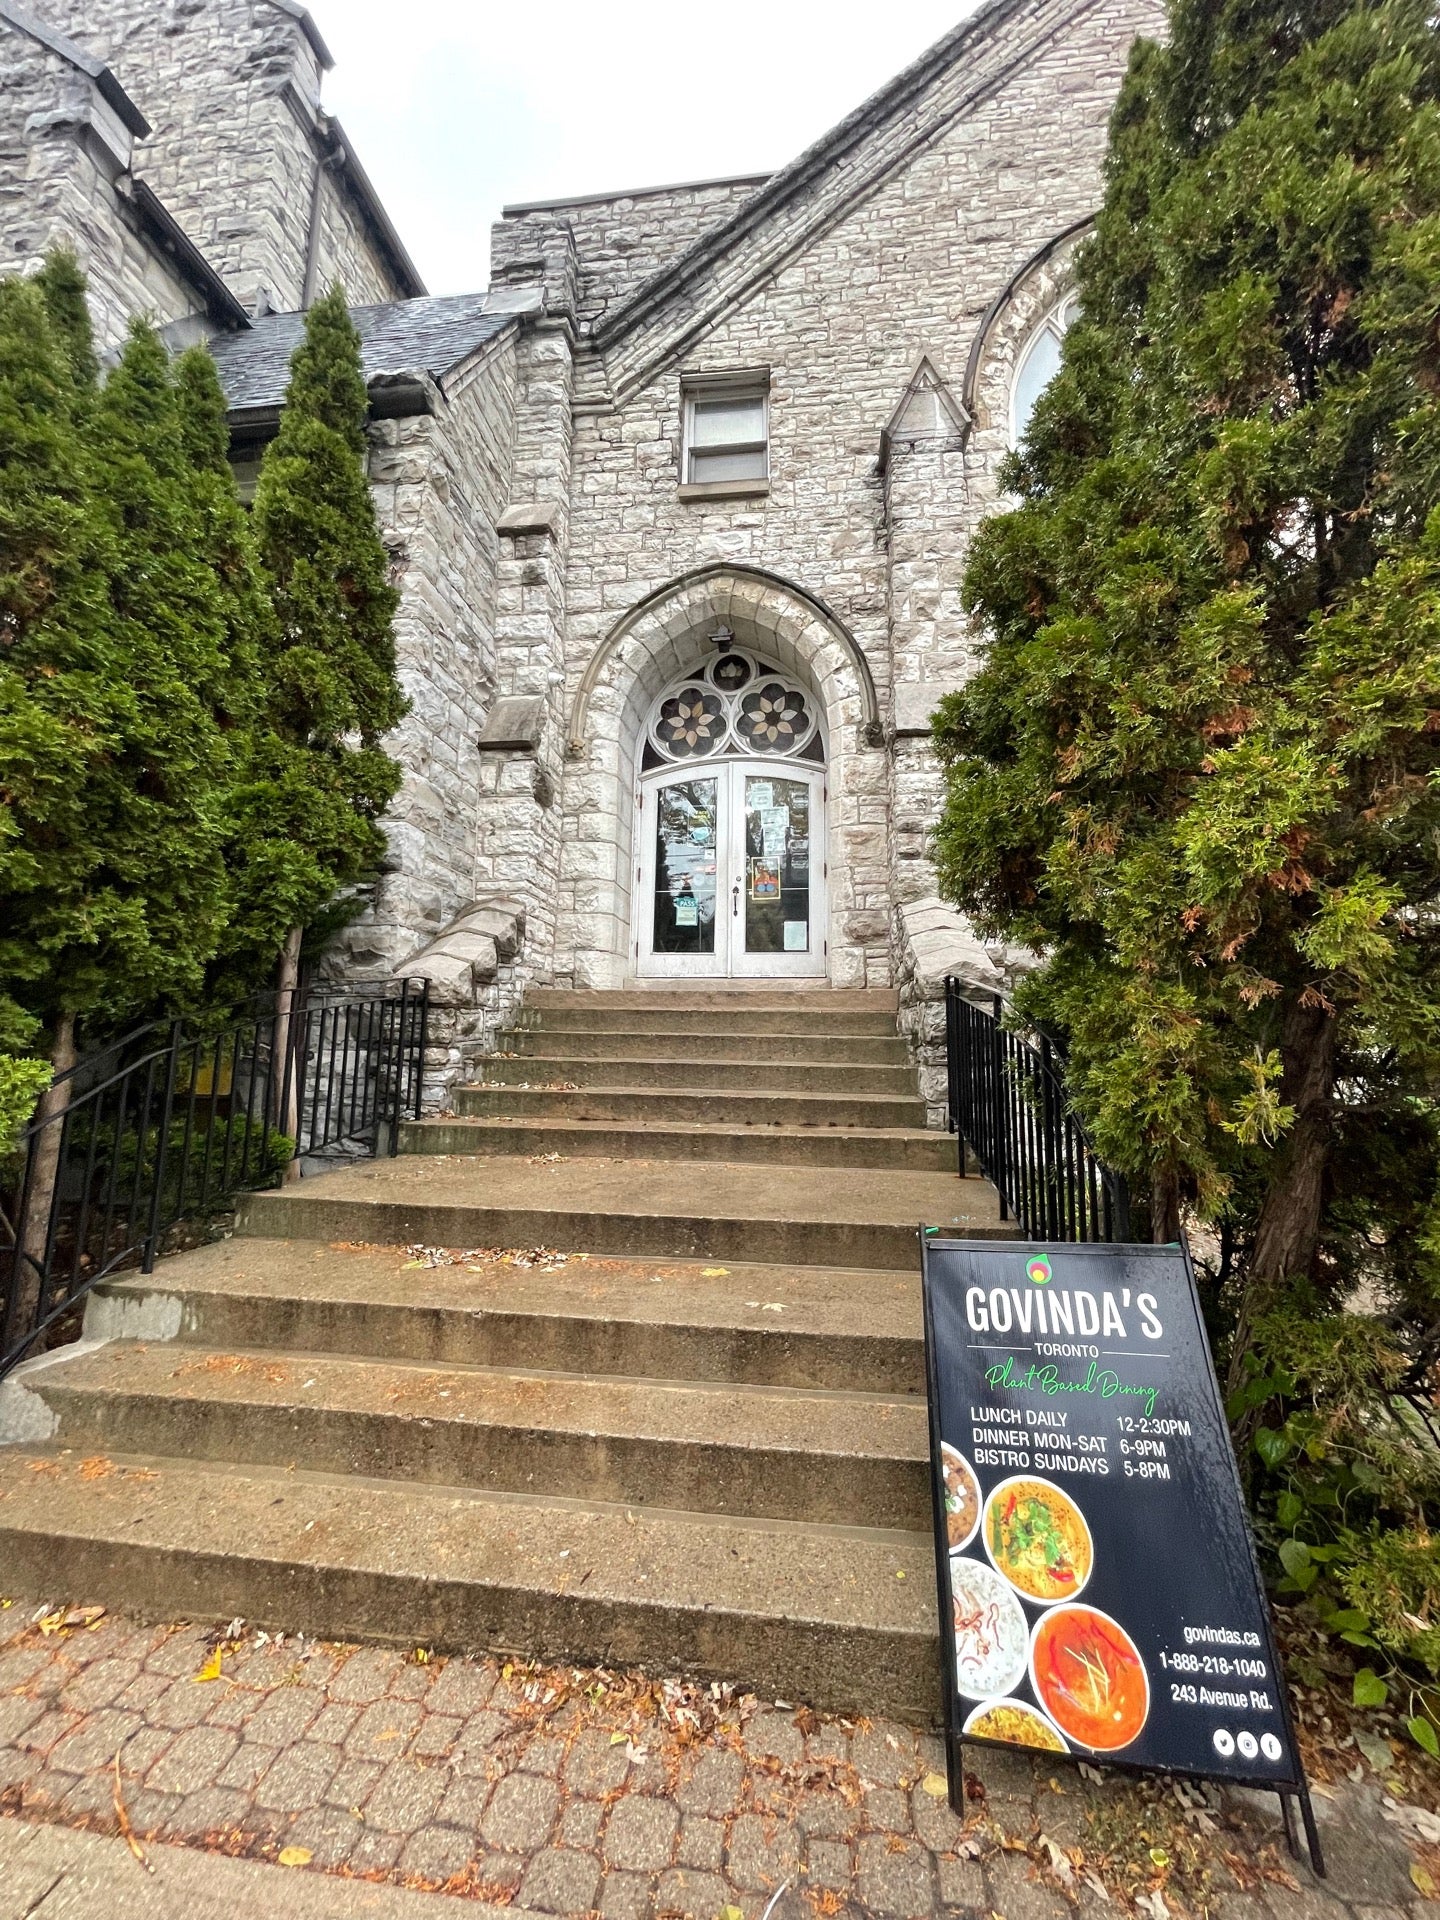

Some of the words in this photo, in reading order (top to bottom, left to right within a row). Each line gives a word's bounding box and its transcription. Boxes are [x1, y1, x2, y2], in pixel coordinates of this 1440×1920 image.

[965, 1287, 1163, 1339] GOVINDA'S
[1034, 1342, 1099, 1358] TORONTO
[984, 1356, 1036, 1392] Plant
[1037, 1361, 1097, 1396] Based
[1096, 1370, 1160, 1417] Dining
[970, 1406, 1022, 1425] LUNCH
[1026, 1409, 1068, 1428] DAILY
[1116, 1416, 1192, 1437] 12-2:30PM
[972, 1427, 1030, 1448] DINNER
[1033, 1432, 1108, 1453] MON-SAT
[1120, 1438, 1167, 1459] 6-9PM
[974, 1448, 1031, 1469] BISTRO
[1034, 1454, 1110, 1475] SUNDAYS
[1124, 1461, 1171, 1480] 5-8PM
[1183, 1625, 1261, 1647] govindas.ca
[1159, 1651, 1267, 1679] 1-888-218-1040
[1170, 1683, 1197, 1703] 243
[1199, 1686, 1248, 1708] Avenue
[1249, 1690, 1274, 1710] Rd.
